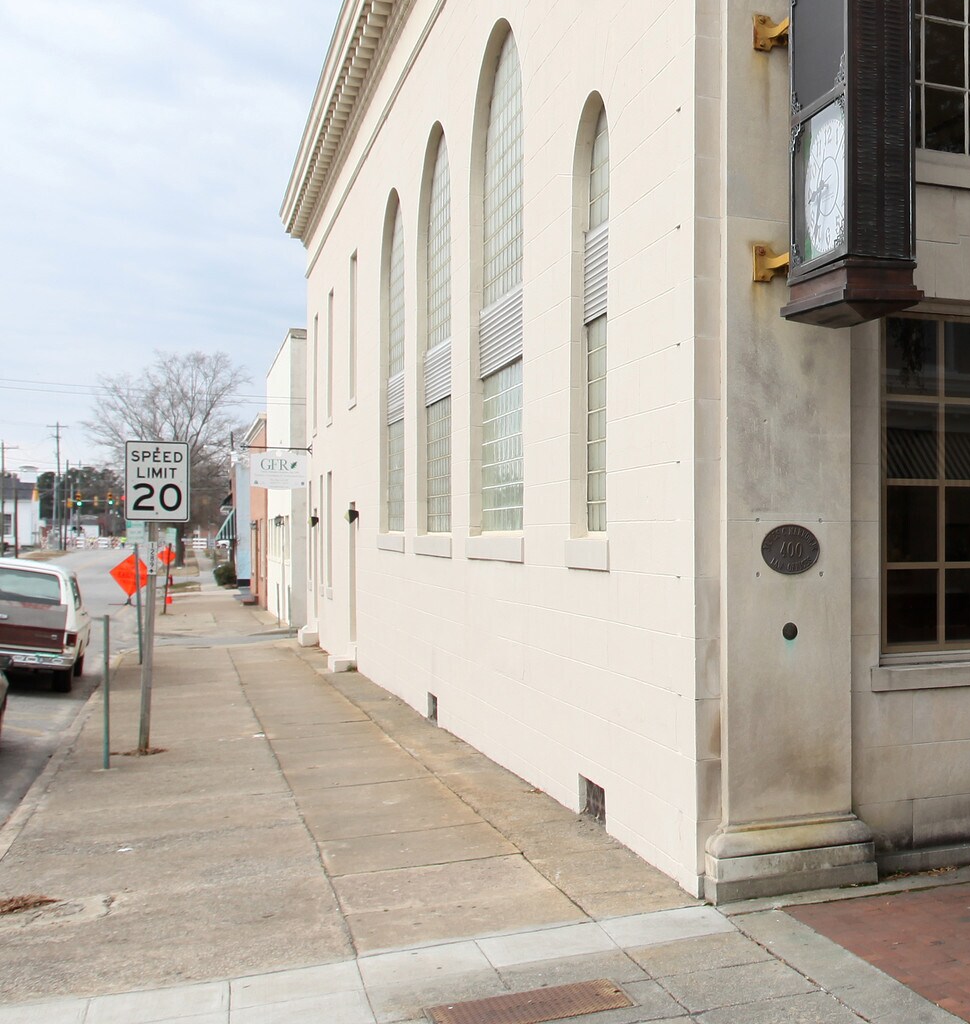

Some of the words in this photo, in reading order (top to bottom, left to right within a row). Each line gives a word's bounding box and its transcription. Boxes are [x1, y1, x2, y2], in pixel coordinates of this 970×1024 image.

[131, 450, 183, 463] SPEED
[260, 458, 289, 471] GFR
[137, 467, 177, 479] LIMIT
[132, 482, 182, 512] 20
[779, 541, 803, 558] 400
